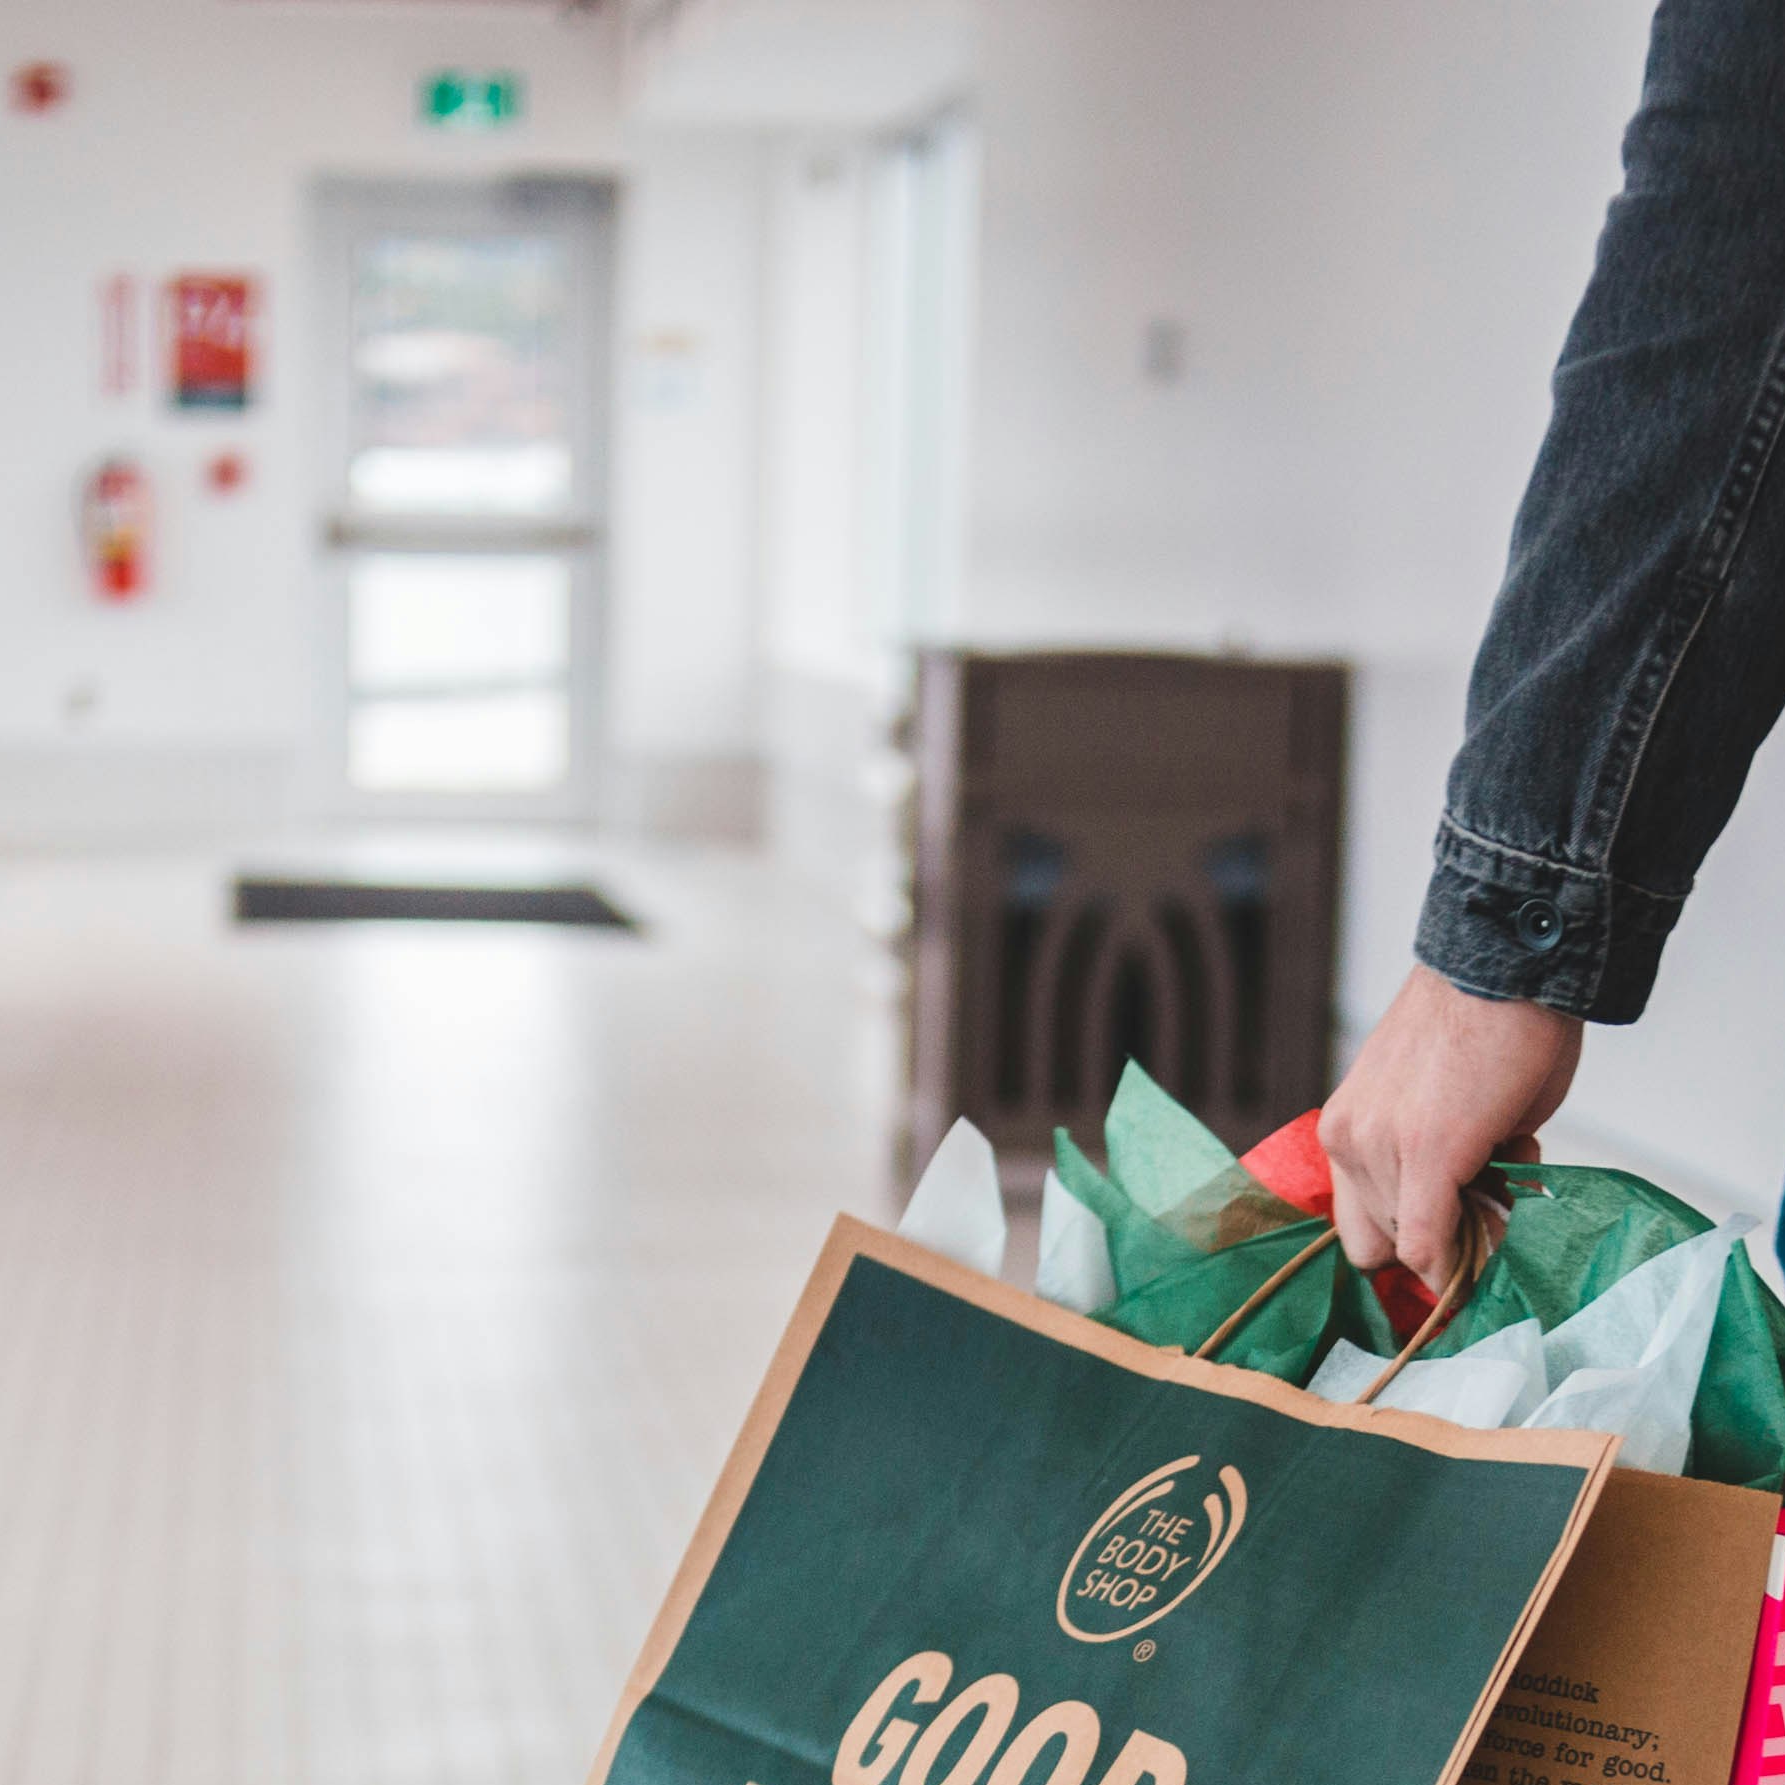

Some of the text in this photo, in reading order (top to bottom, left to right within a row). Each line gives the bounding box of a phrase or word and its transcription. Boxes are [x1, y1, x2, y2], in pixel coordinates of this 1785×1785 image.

[1137, 1508, 1194, 1546] THE
[1097, 1534, 1192, 1582] BODY
[1076, 1568, 1157, 1611] SHOP
[1492, 1701, 1660, 1751] evolutionary;
[1553, 1741, 1594, 1768] for
[1603, 1755, 1671, 1784] good.
